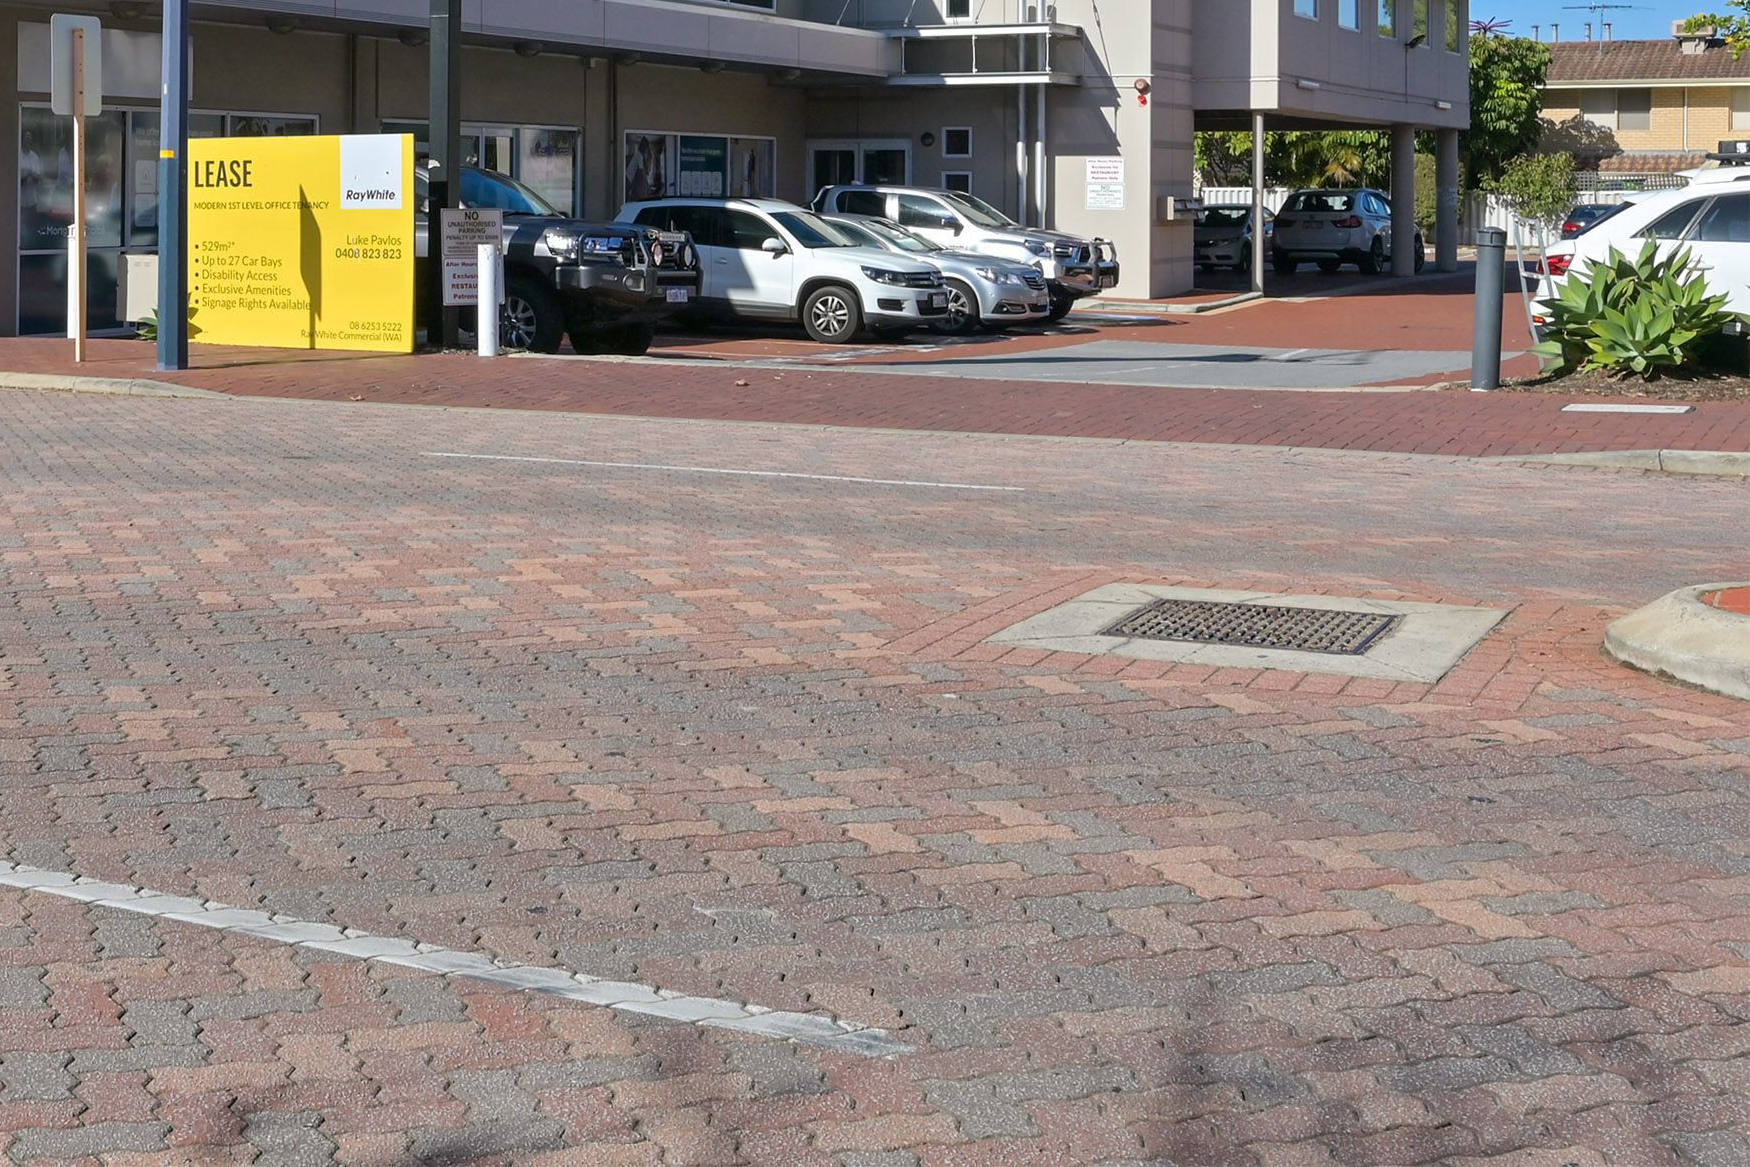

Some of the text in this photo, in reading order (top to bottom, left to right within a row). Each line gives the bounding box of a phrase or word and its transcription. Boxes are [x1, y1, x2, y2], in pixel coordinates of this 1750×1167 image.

[194, 159, 253, 188] LEASE
[194, 201, 330, 210] MODERN 1ST LEVEL OFFICE TENANCY
[464, 211, 479, 220] NO
[447, 220, 497, 228] UNAUTHORISED
[346, 235, 402, 246] Luke Pavlos
[335, 247, 402, 259] 0408 823 823
[202, 255, 283, 269] Up to 27 Car Bays
[202, 269, 278, 282] Disability Access
[202, 283, 292, 296] Exclusive Amenities
[201, 297, 311, 311] Signage Rights Available
[349, 321, 402, 332] 08 6253 5222
[314, 330, 338, 339] White
[338, 331, 381, 341] Commercial
[383, 332, 402, 343] (WA)
